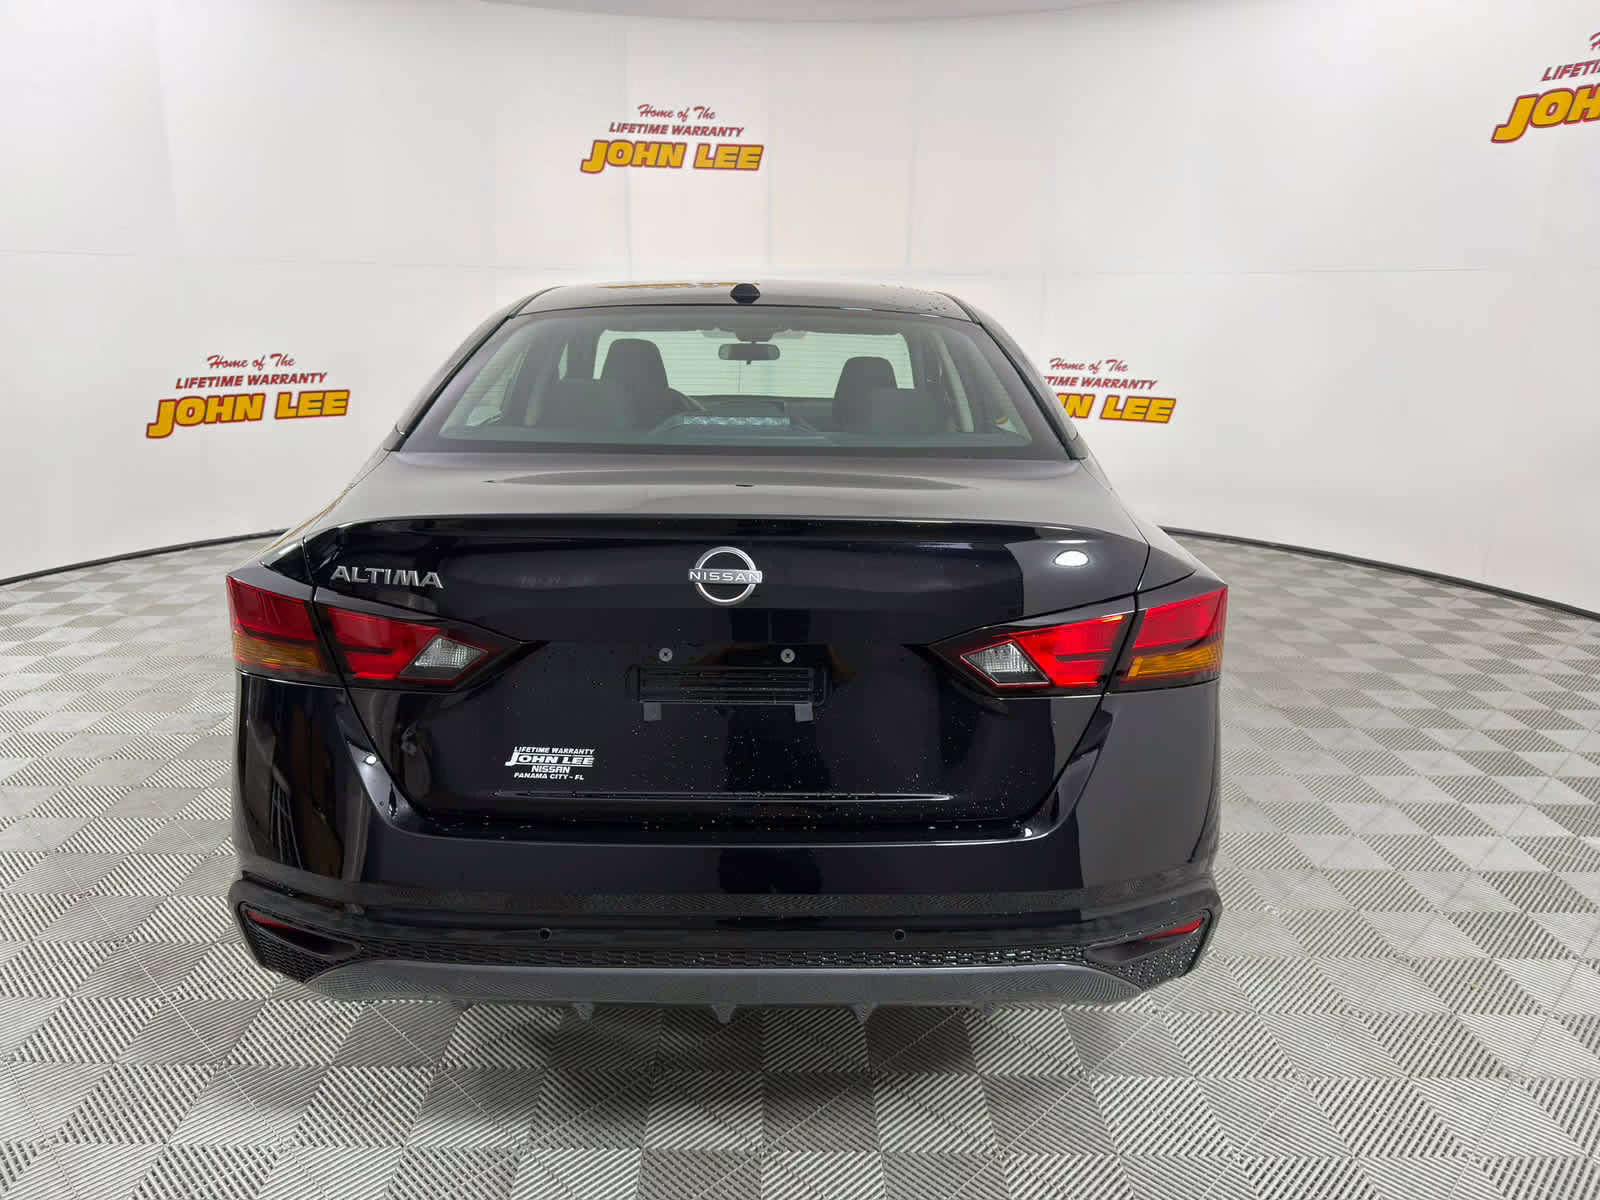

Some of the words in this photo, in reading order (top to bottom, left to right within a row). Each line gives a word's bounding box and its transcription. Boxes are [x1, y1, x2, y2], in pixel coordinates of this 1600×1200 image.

[1541, 59, 1600, 81] LIFETI
[638, 104, 674, 119] Home
[677, 107, 690, 122] of
[694, 105, 716, 120] The
[1491, 83, 1600, 144] JOH
[609, 122, 668, 135] LIFETIME
[671, 124, 744, 137] WARRANTY
[580, 139, 687, 174] JOHN
[693, 142, 764, 171] LEE
[207, 354, 248, 369] Home
[252, 355, 266, 371] of
[269, 353, 296, 367] The
[1049, 357, 1086, 371] Home
[1088, 360, 1102, 374] of
[1105, 359, 1129, 372] The
[175, 375, 243, 389] LIFETIME
[247, 372, 328, 387] WARRANTY
[1081, 377, 1158, 390] WARRANTY
[146, 393, 266, 439] JOHN
[274, 389, 350, 420] LEE
[1100, 394, 1177, 424] LEE
[330, 565, 444, 589] ALTIMA
[689, 571, 761, 582] NISSAN
[504, 750, 559, 767] JOHN
[562, 756, 595, 765] LEE
[551, 747, 595, 755] WARRANTY
[531, 765, 571, 774] NISSAN
